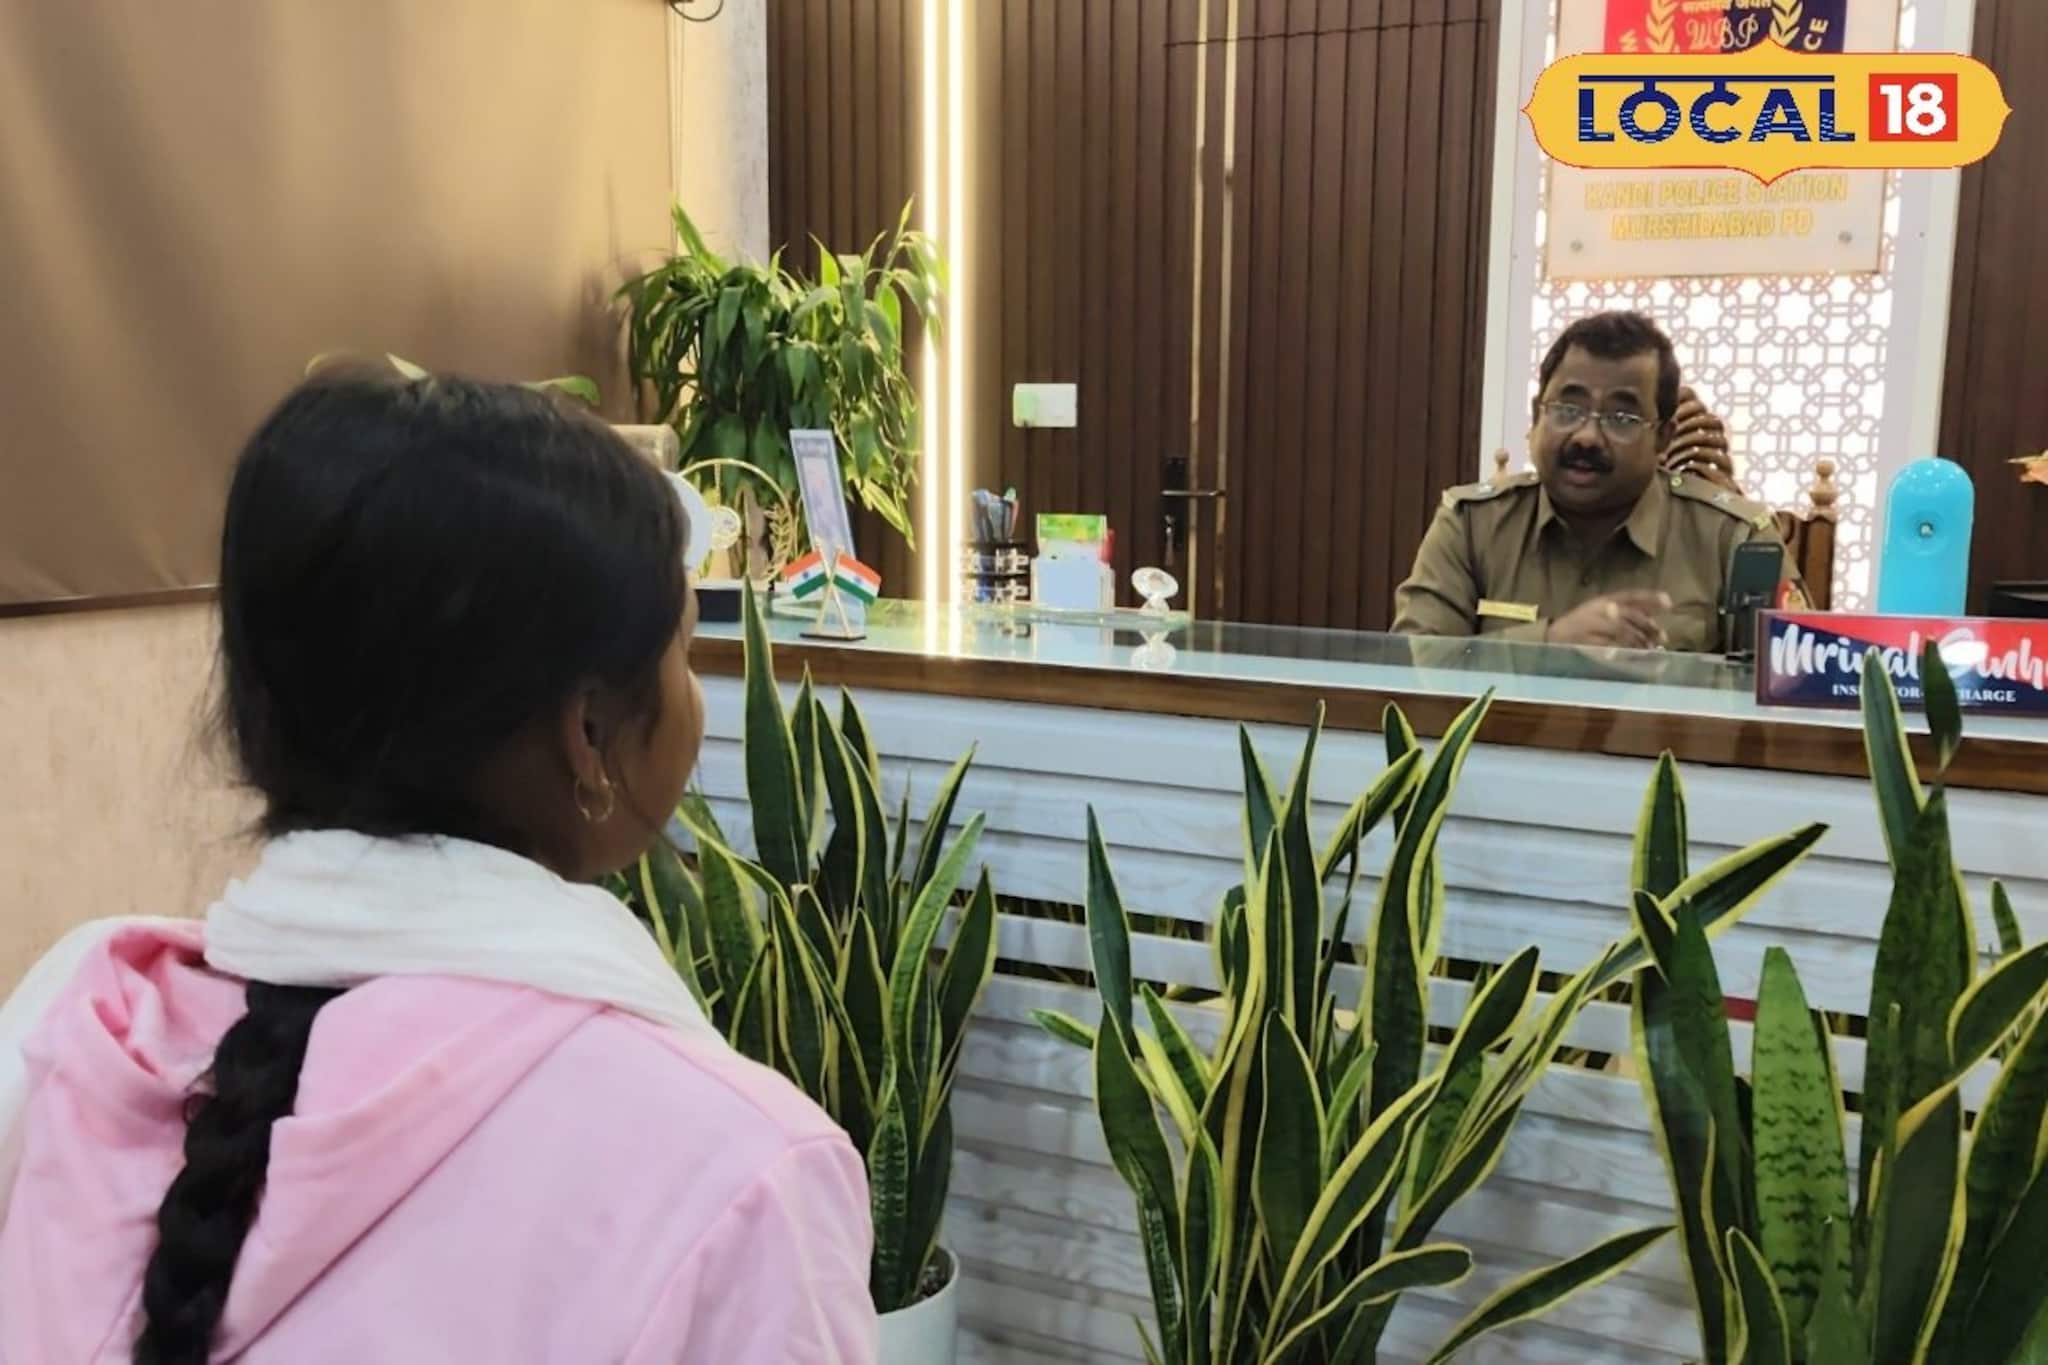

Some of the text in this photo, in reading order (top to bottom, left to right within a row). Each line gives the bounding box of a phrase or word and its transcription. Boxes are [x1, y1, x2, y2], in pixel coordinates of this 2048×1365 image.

[1686, 13, 1759, 48] WBP
[1661, 179, 1740, 205] POLICE
[1612, 212, 1775, 240] MURSHIDABAD
